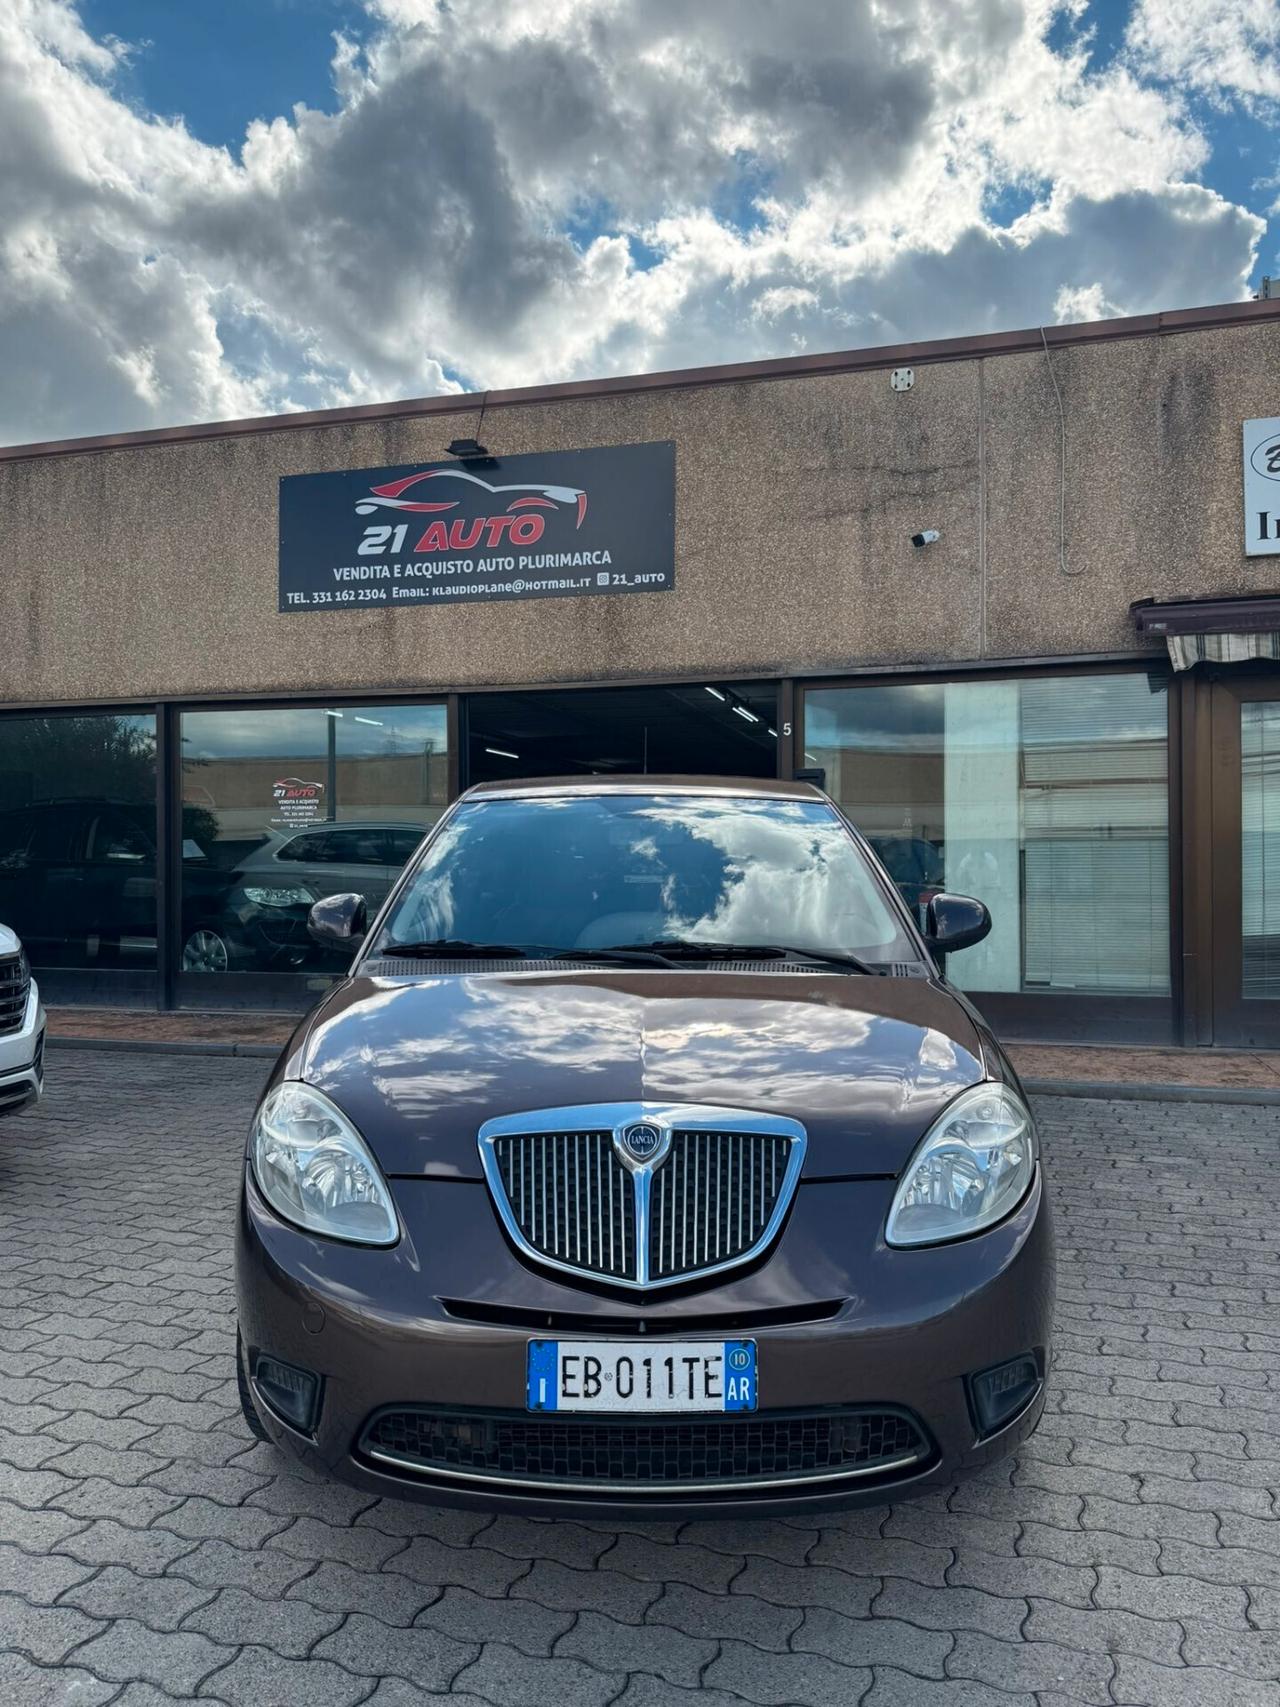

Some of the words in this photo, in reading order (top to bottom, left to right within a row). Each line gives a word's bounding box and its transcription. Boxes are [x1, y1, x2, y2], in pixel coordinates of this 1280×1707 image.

[357, 524, 408, 555] 21
[414, 514, 545, 552] AUTO
[1257, 511, 1280, 540] I
[333, 565, 391, 581] VENDITA
[394, 563, 402, 577] E
[405, 559, 474, 578] ACQUISTO
[477, 557, 515, 573] AUTO
[519, 550, 612, 570] PLURIMARCA
[287, 592, 310, 604] TEL.
[312, 591, 333, 604] 331
[335, 590, 356, 602] 162
[358, 588, 387, 601] 2304
[783, 722, 791, 736] 5
[631, 1135, 654, 1144] LANCIA
[734, 1353, 746, 1366] 10
[727, 1376, 750, 1401] AR
